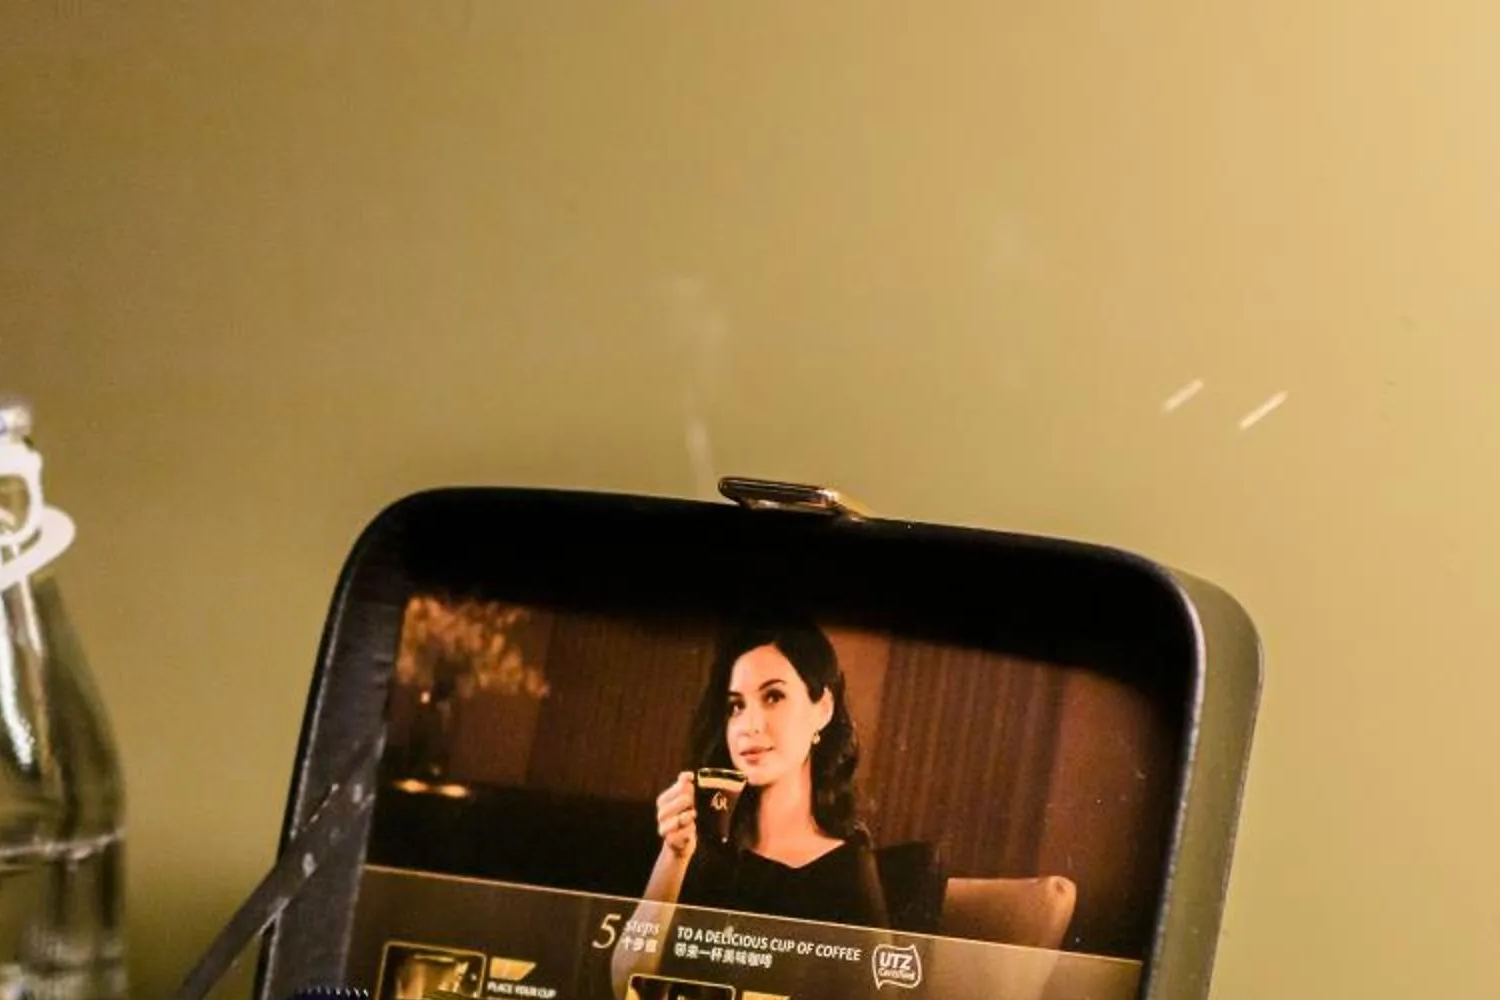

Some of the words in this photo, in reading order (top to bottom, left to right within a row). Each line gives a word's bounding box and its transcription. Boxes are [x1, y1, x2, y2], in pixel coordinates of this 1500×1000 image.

[591, 913, 622, 949] 5
[677, 926, 693, 941] TO
[694, 929, 703, 942] A
[705, 929, 768, 950] DELICIOUS
[769, 937, 795, 952] CUP
[797, 942, 814, 955] OF
[815, 945, 862, 961] COFFEE
[879, 951, 913, 970] UTZ
